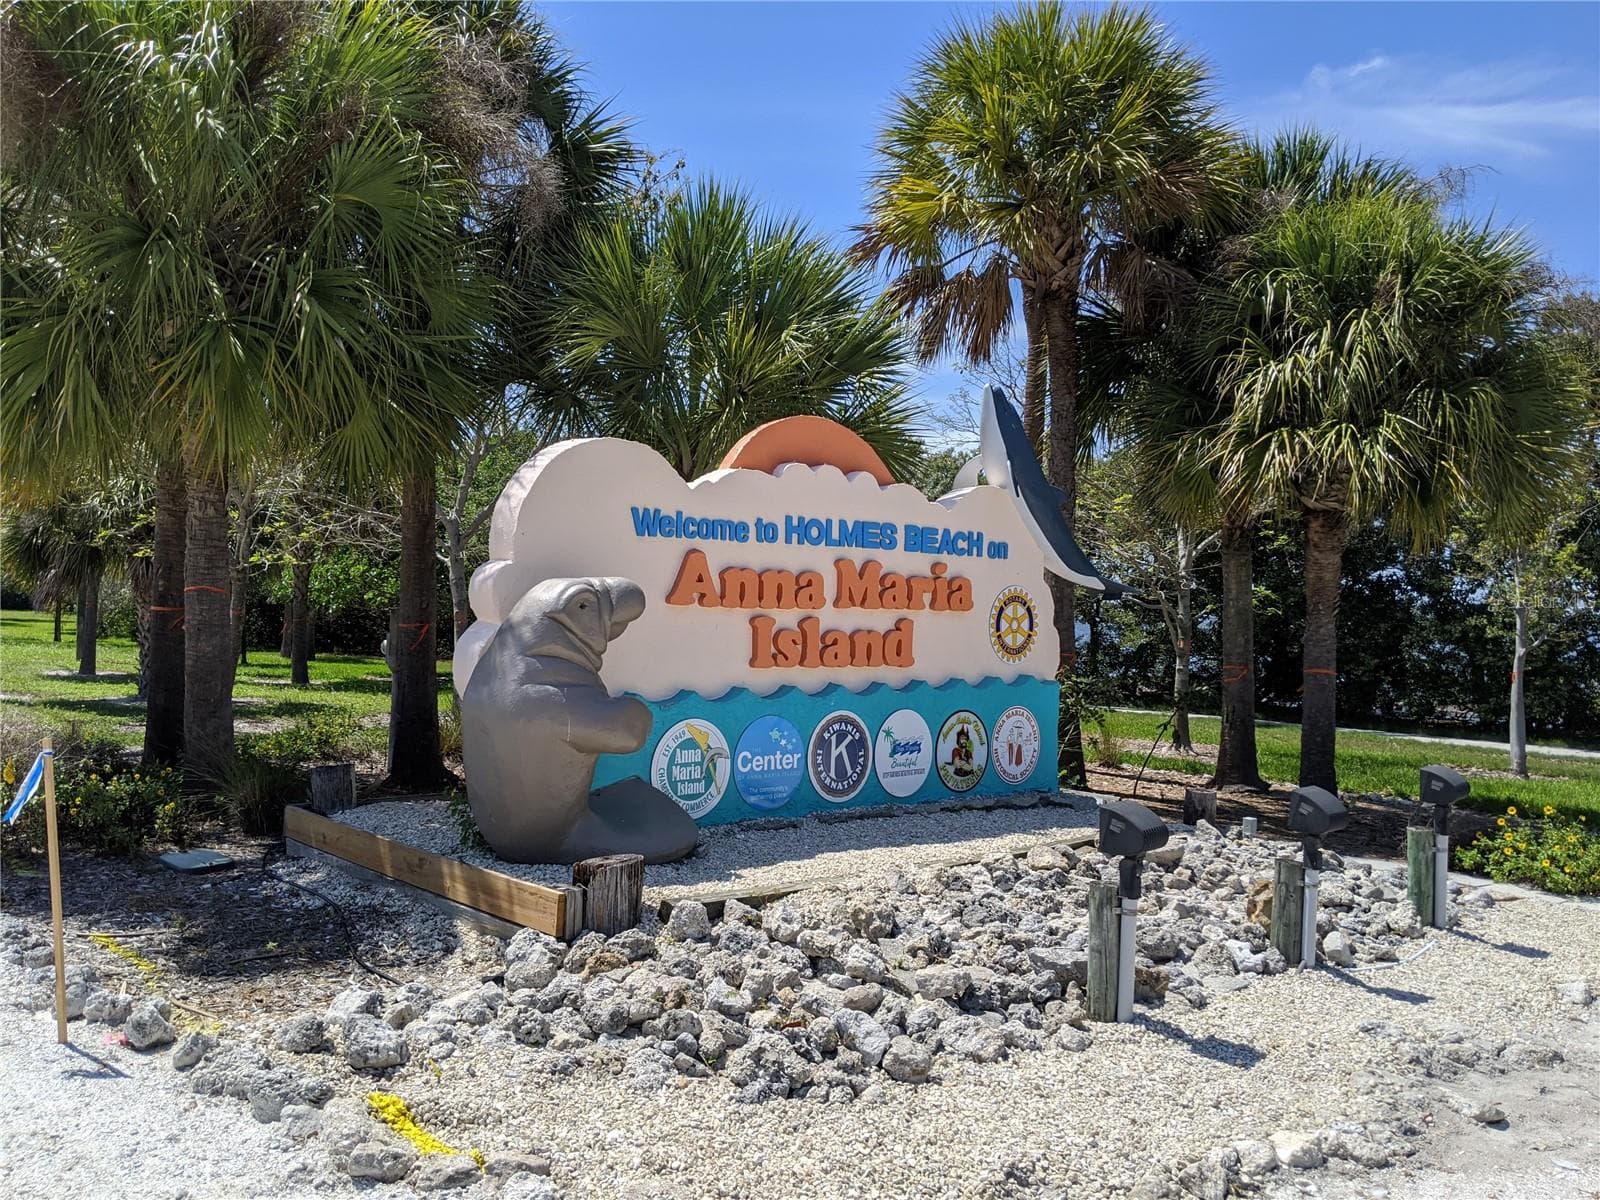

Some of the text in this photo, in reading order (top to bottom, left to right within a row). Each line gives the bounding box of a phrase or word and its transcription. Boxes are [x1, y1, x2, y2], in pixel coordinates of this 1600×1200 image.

[631, 506, 1008, 559] Welcome to HOLMES BEACH on
[664, 548, 974, 611] Anna Maria
[749, 615, 915, 668] Island
[823, 722, 861, 740] KIWANIS
[995, 710, 1038, 743] ANNA MARIA ISLAND
[662, 729, 686, 758] EST. 1949
[674, 748, 701, 765] Anna
[830, 732, 854, 780] K
[672, 764, 701, 782] Maria
[737, 750, 802, 773] Center
[816, 748, 865, 790] INTERNATIONAL
[1019, 748, 1037, 780] SOCIETY
[677, 780, 705, 796] Island
[682, 793, 715, 812] COMMERCE
